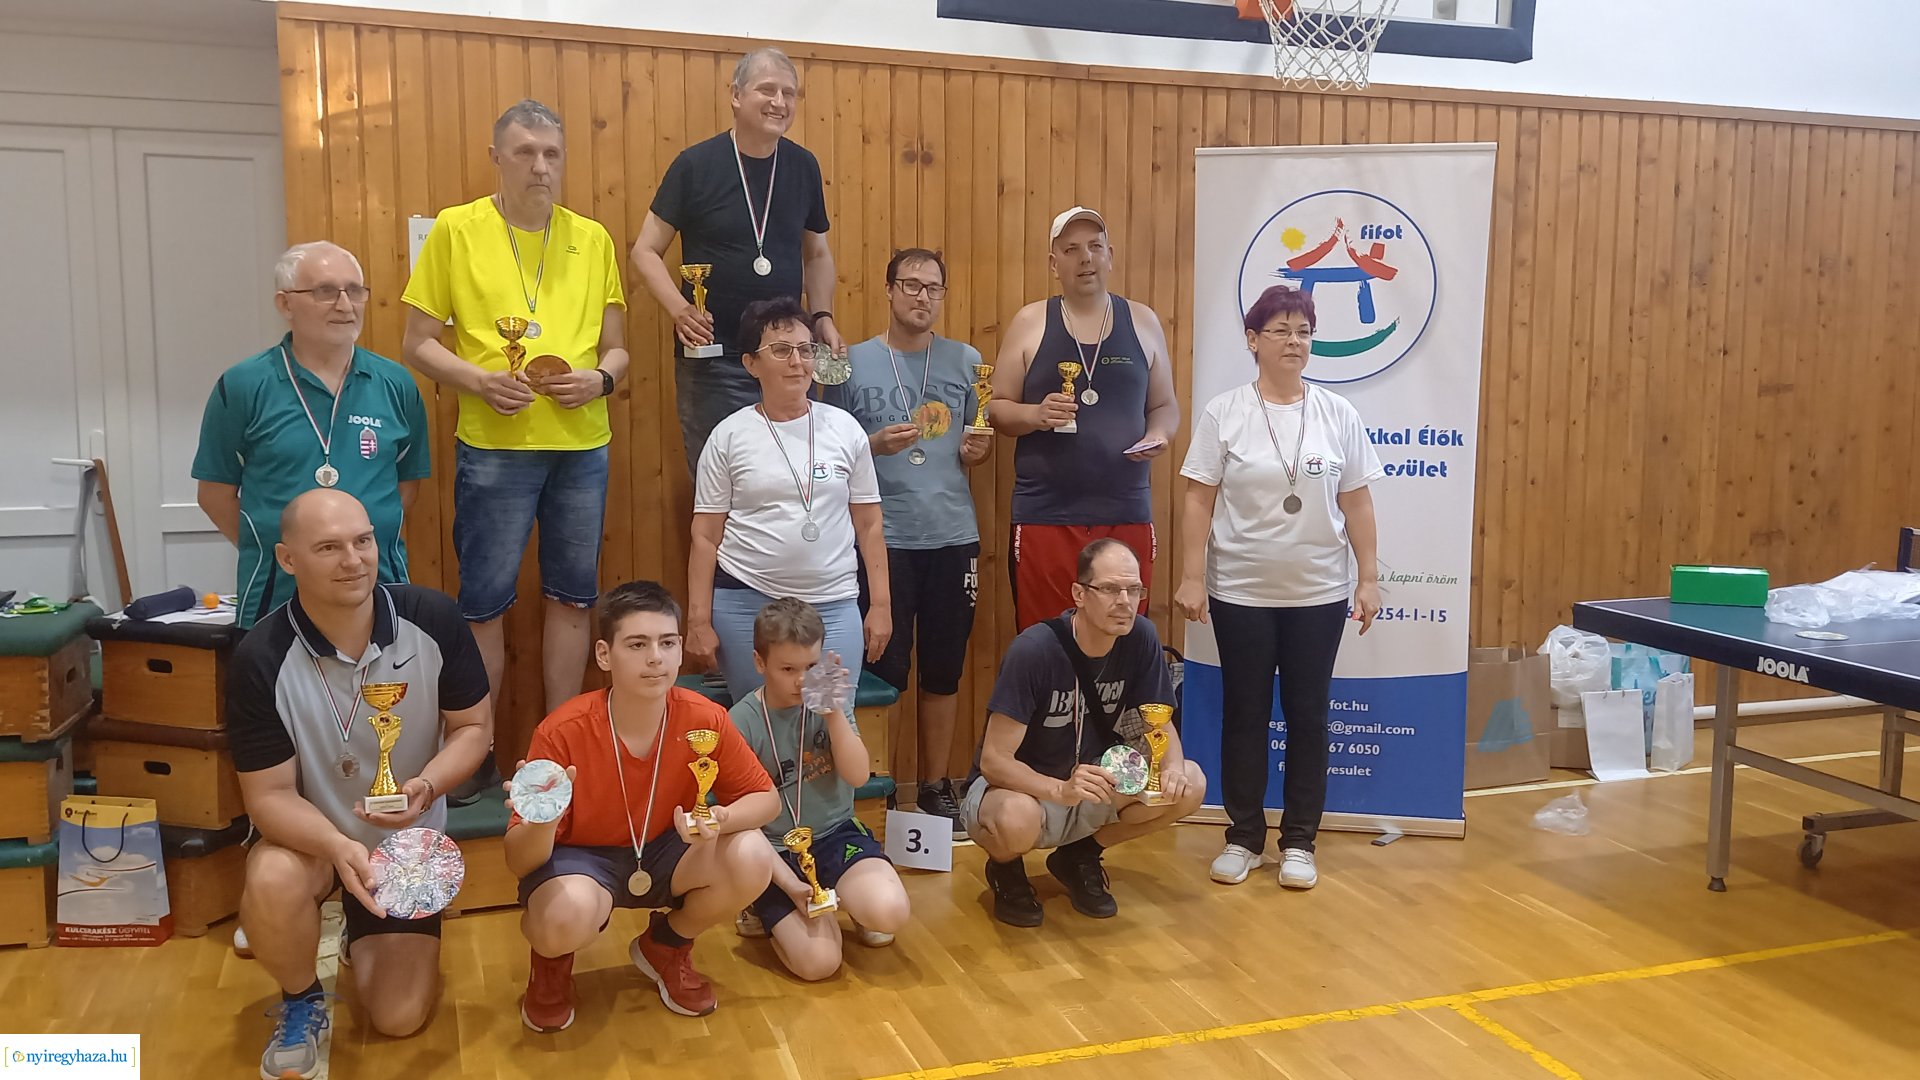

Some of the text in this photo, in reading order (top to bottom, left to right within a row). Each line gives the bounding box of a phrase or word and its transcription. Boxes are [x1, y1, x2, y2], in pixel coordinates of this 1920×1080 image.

[1360, 224, 1403, 240] fifot
[861, 383, 965, 413] BOSS
[348, 414, 382, 428] JOOLA
[1418, 424, 1464, 446] Élők
[1383, 459, 1447, 477] esület
[963, 572, 979, 589] FO
[1388, 570, 1424, 586] kapni
[1426, 573, 1459, 585] öröm
[1756, 655, 1810, 684] JOOLA
[1329, 699, 1369, 712] fot.hu
[1271, 739, 1380, 756] 06 67 6050
[905, 828, 930, 855] 3.
